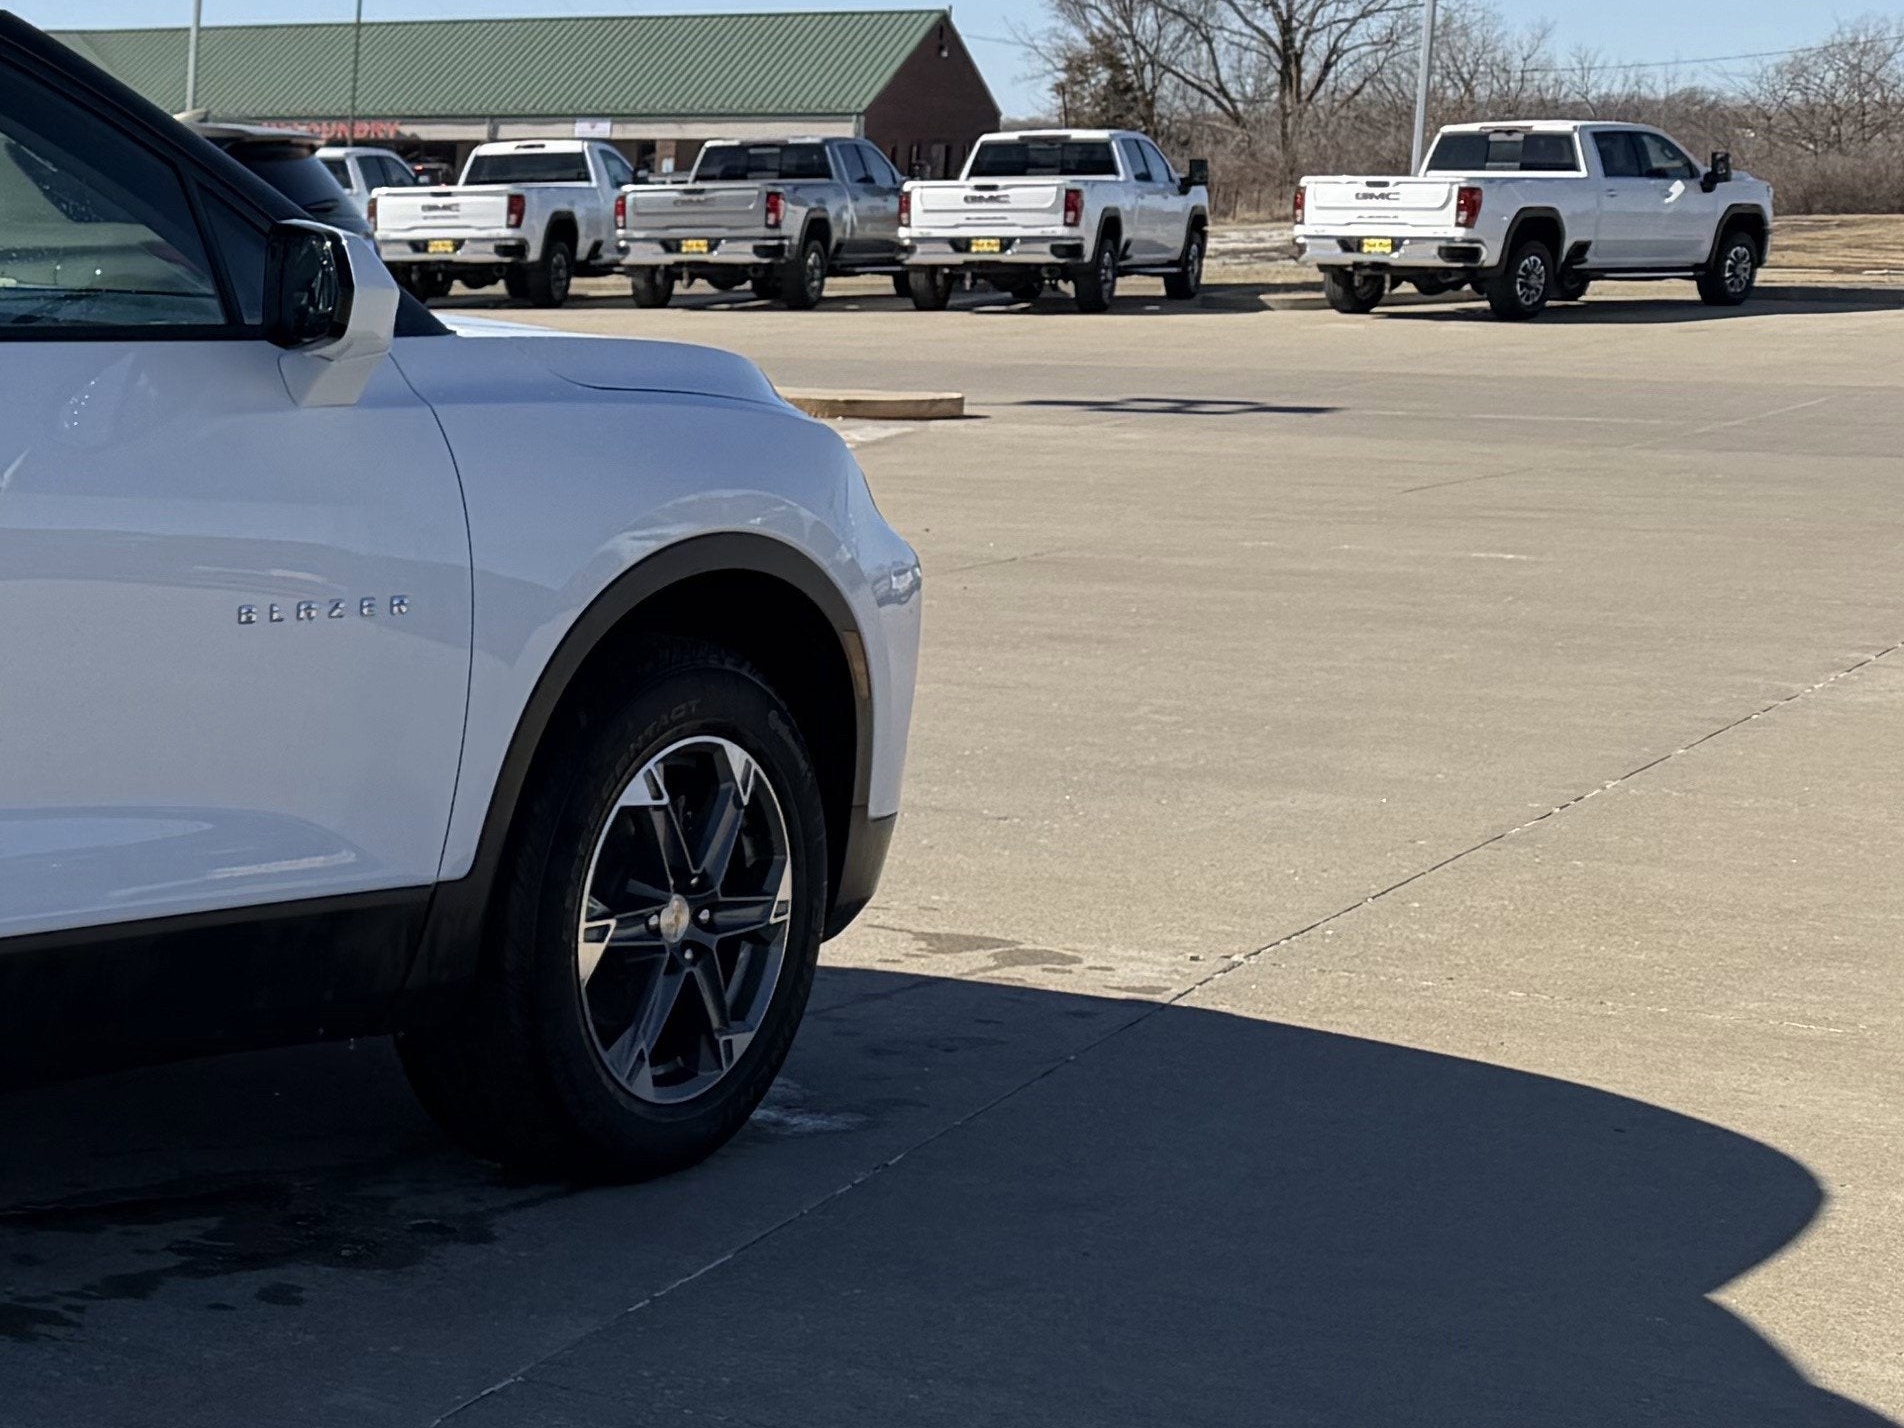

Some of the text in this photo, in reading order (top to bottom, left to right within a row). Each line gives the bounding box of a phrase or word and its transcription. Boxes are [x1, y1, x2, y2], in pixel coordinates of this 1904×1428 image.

[963, 194, 1011, 205] GMC
[1355, 191, 1401, 201] GMC
[236, 593, 411, 625] BLAZER
